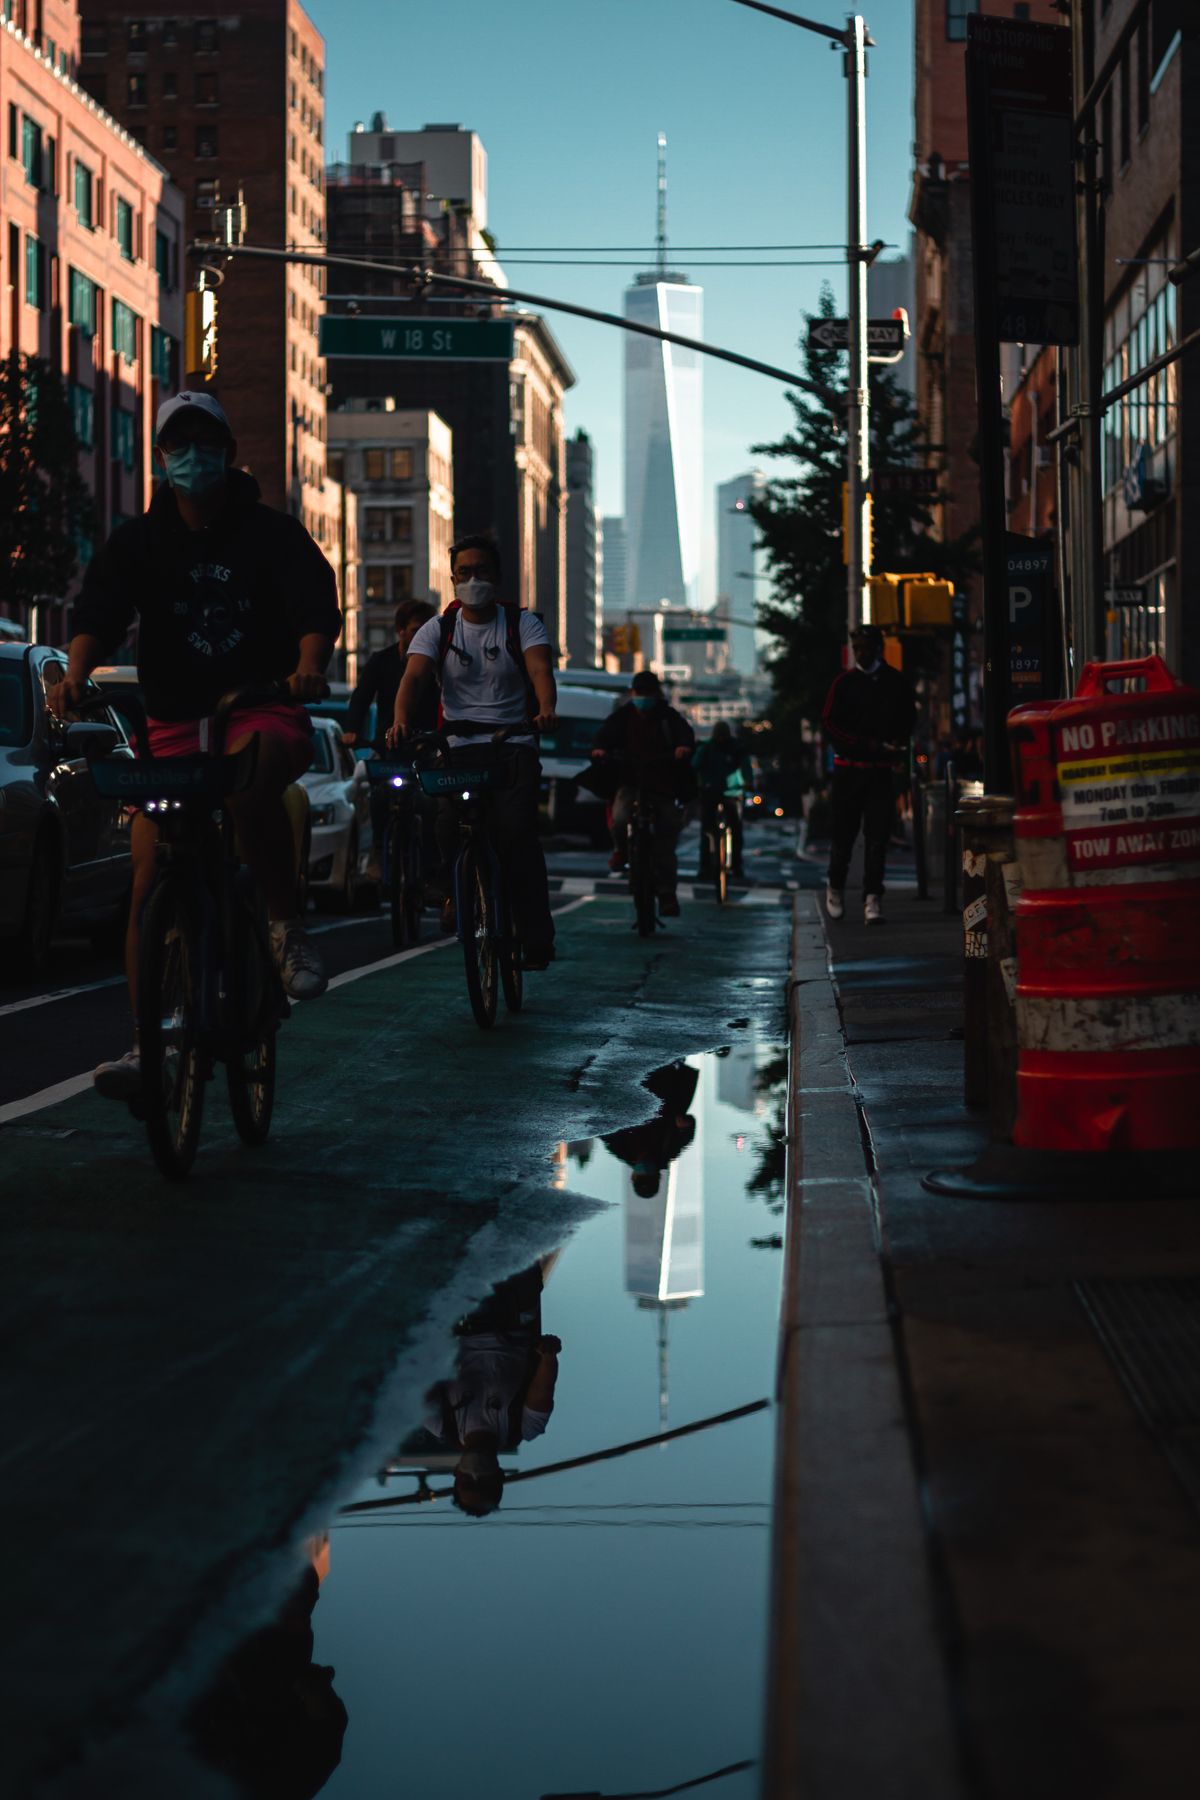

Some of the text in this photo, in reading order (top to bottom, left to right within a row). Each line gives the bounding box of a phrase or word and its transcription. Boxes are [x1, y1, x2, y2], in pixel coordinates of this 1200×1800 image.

[993, 167, 1055, 188] MMERCIAL
[381, 330, 453, 350] W 18 St
[1007, 559, 1048, 571] 04897
[1009, 585, 1033, 623] P
[1061, 714, 1199, 752] NO PARKING
[1074, 784, 1127, 805] MONDAY
[1131, 781, 1157, 799] thru
[1100, 806, 1128, 821] 7am
[1131, 805, 1144, 818] to
[1072, 827, 1200, 860] TOW AWAY ZON
